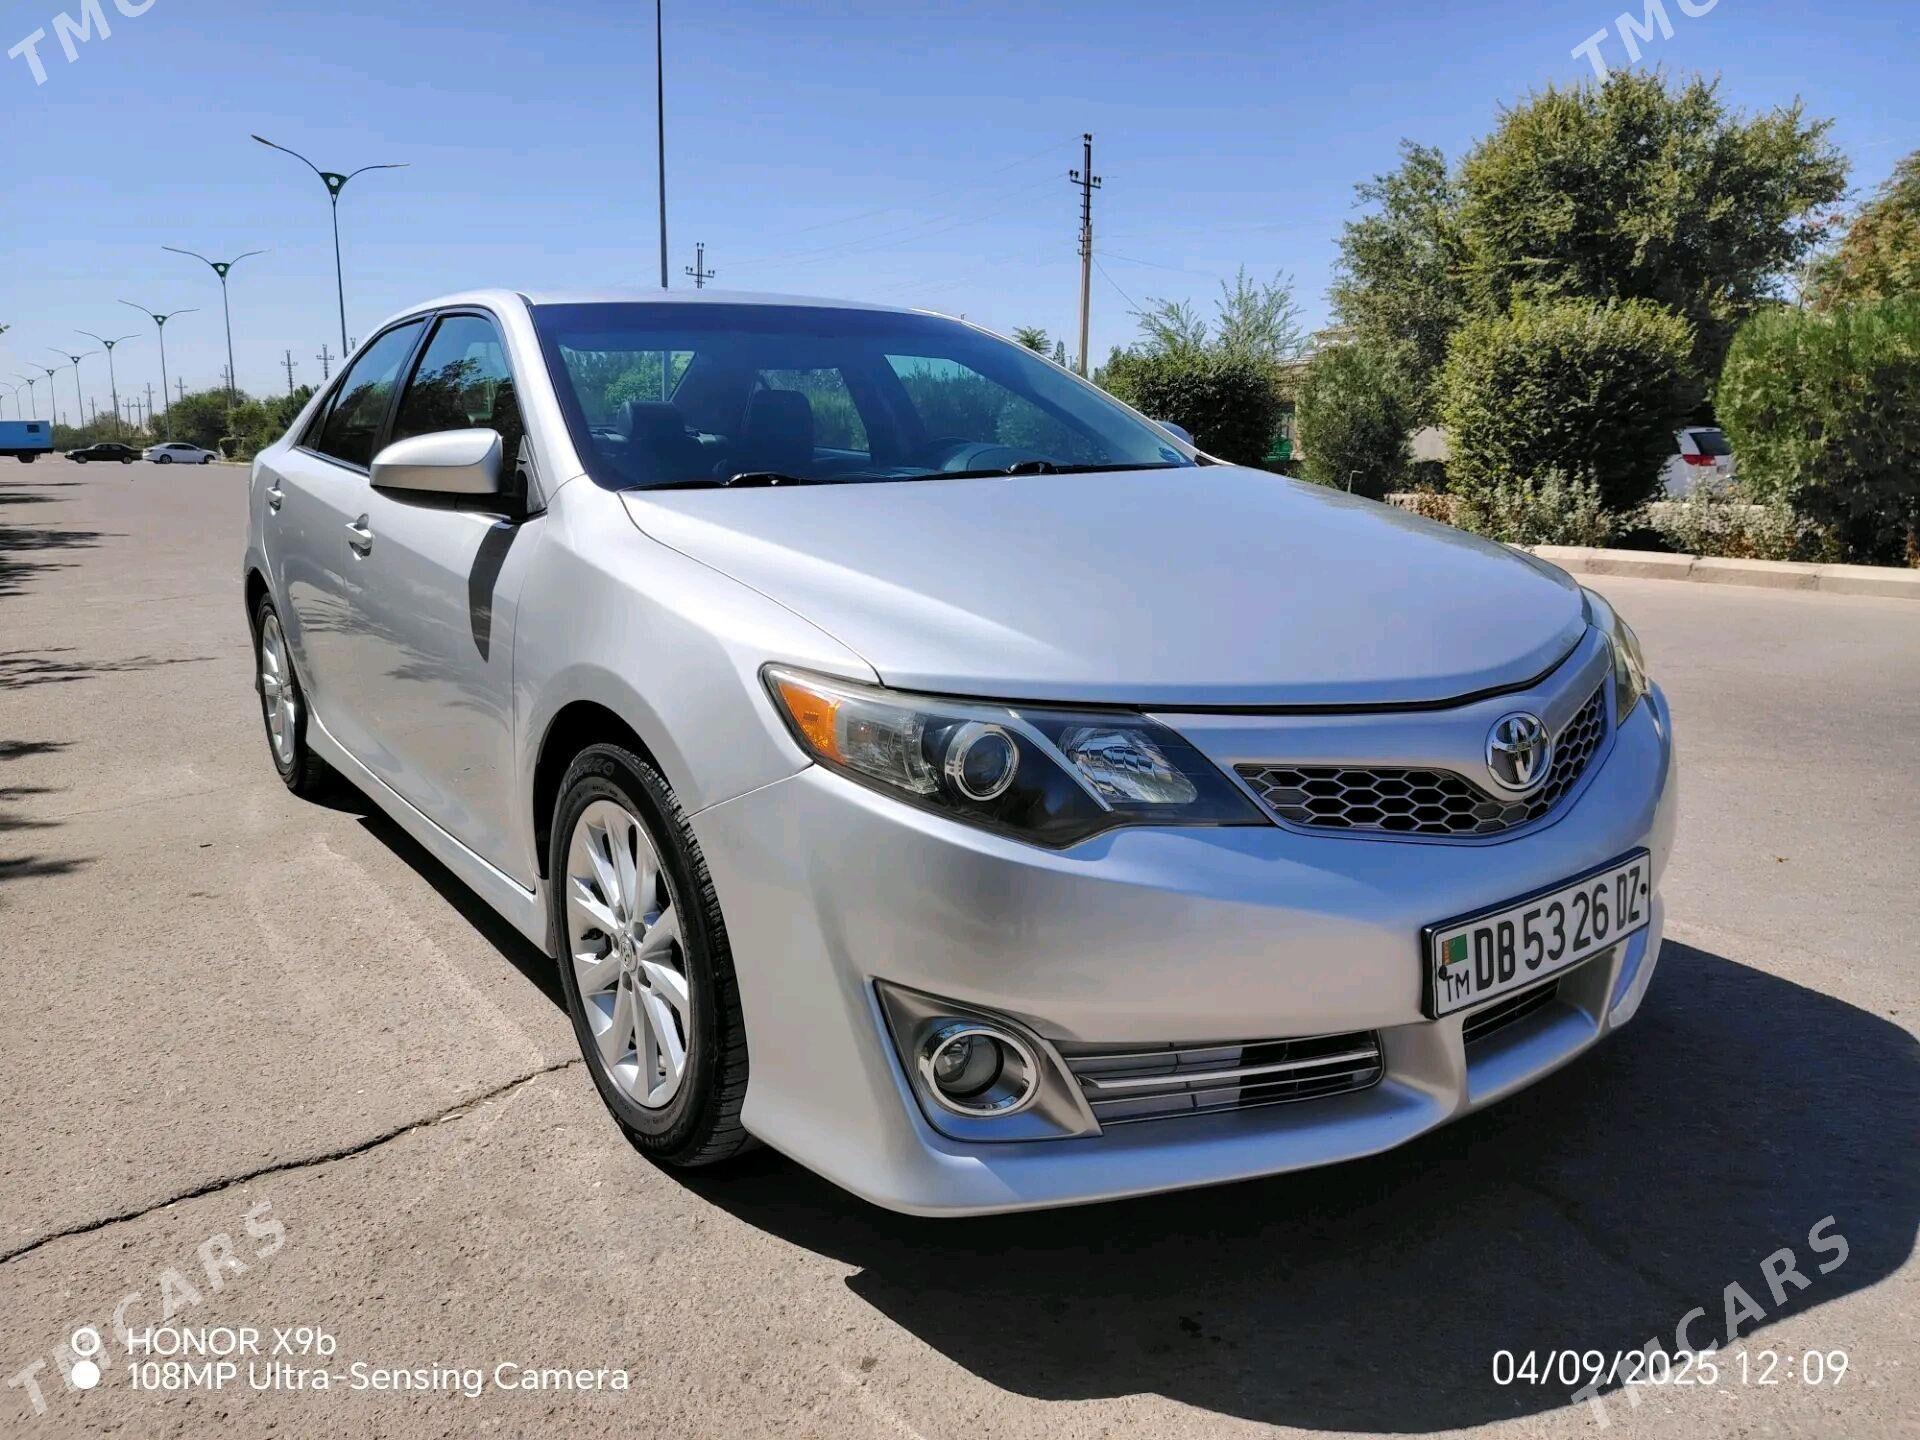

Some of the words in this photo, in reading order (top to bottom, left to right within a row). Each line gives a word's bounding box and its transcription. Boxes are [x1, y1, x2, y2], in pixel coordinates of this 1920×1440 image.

[1474, 921, 1517, 992] DB
[1616, 865, 1641, 932] DZ
[1442, 969, 1470, 1003] TM
